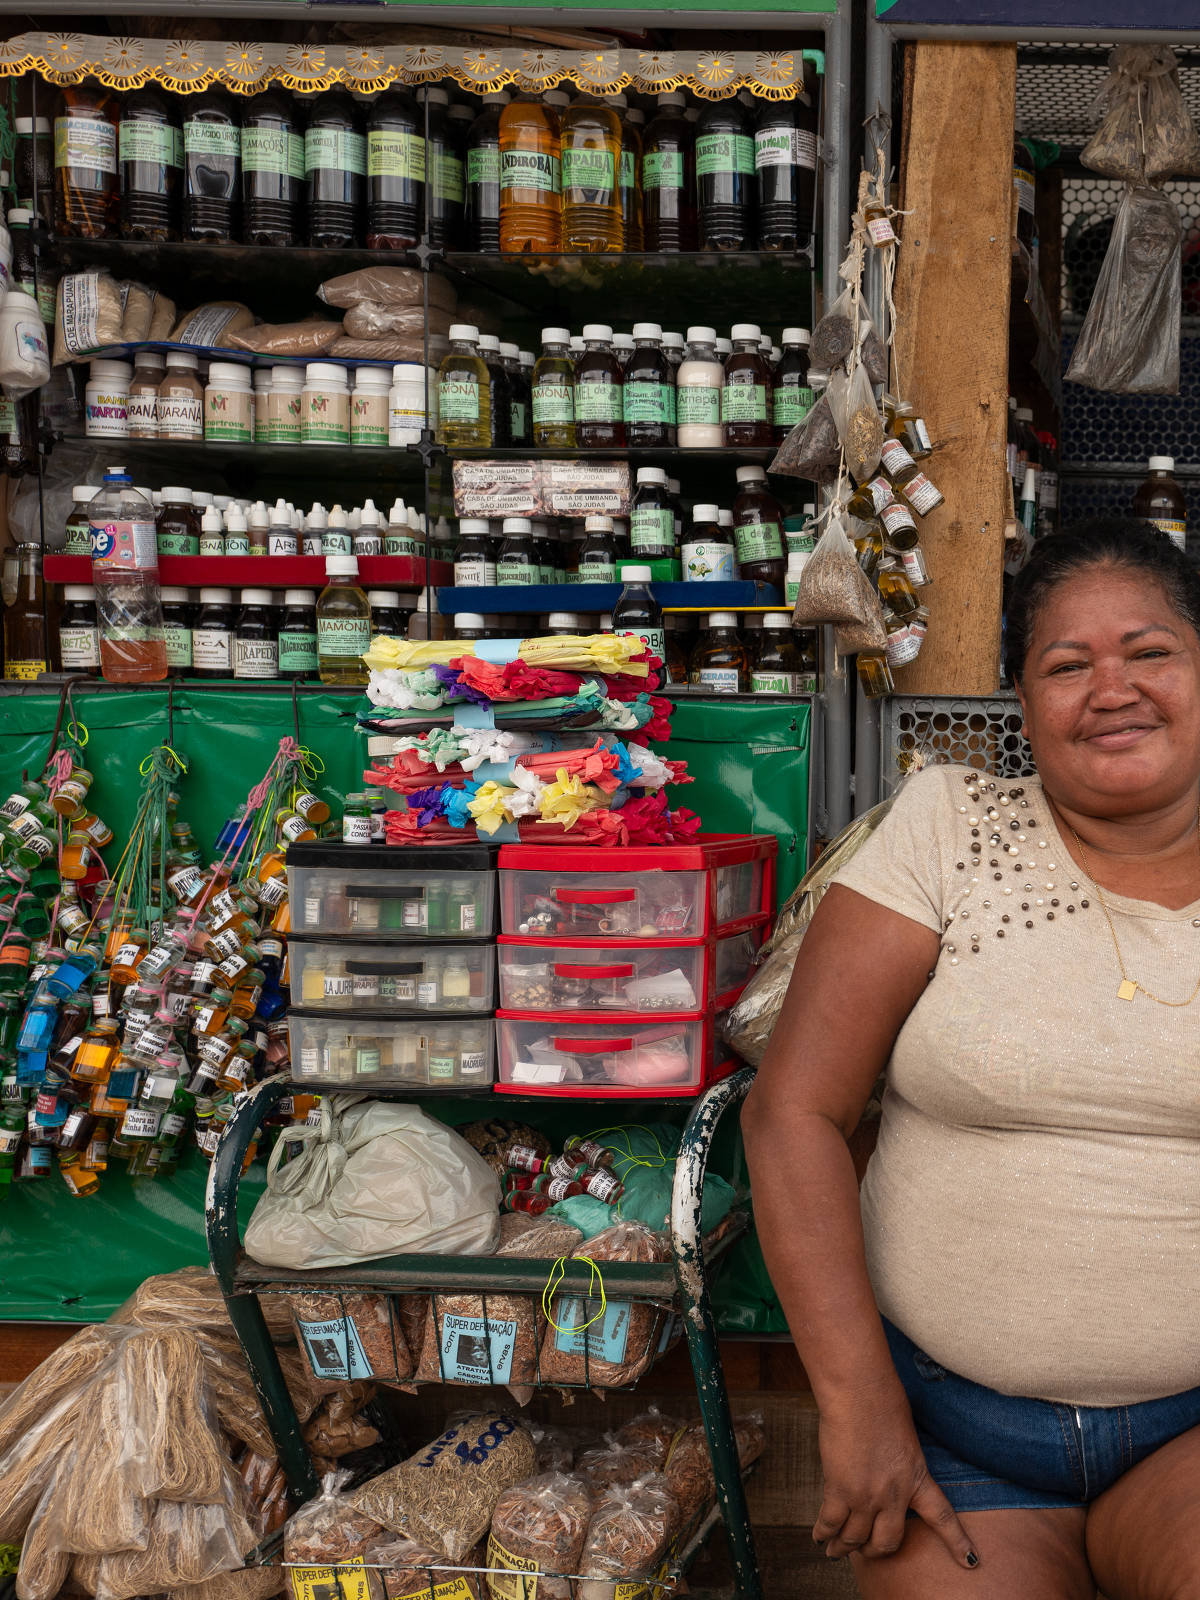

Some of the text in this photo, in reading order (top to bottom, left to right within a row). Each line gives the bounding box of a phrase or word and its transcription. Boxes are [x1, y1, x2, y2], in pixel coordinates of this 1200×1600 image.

[67, 326, 77, 341] DE
[679, 395, 717, 405] Amapá
[319, 621, 369, 634] MAMONA
[128, 1116, 147, 1124] Chora
[445, 1317, 513, 1337] SUPER DEFUMAÇÃO
[444, 1330, 457, 1353] com
[497, 1343, 512, 1370] ervas
[296, 1570, 317, 1582] SUPER
